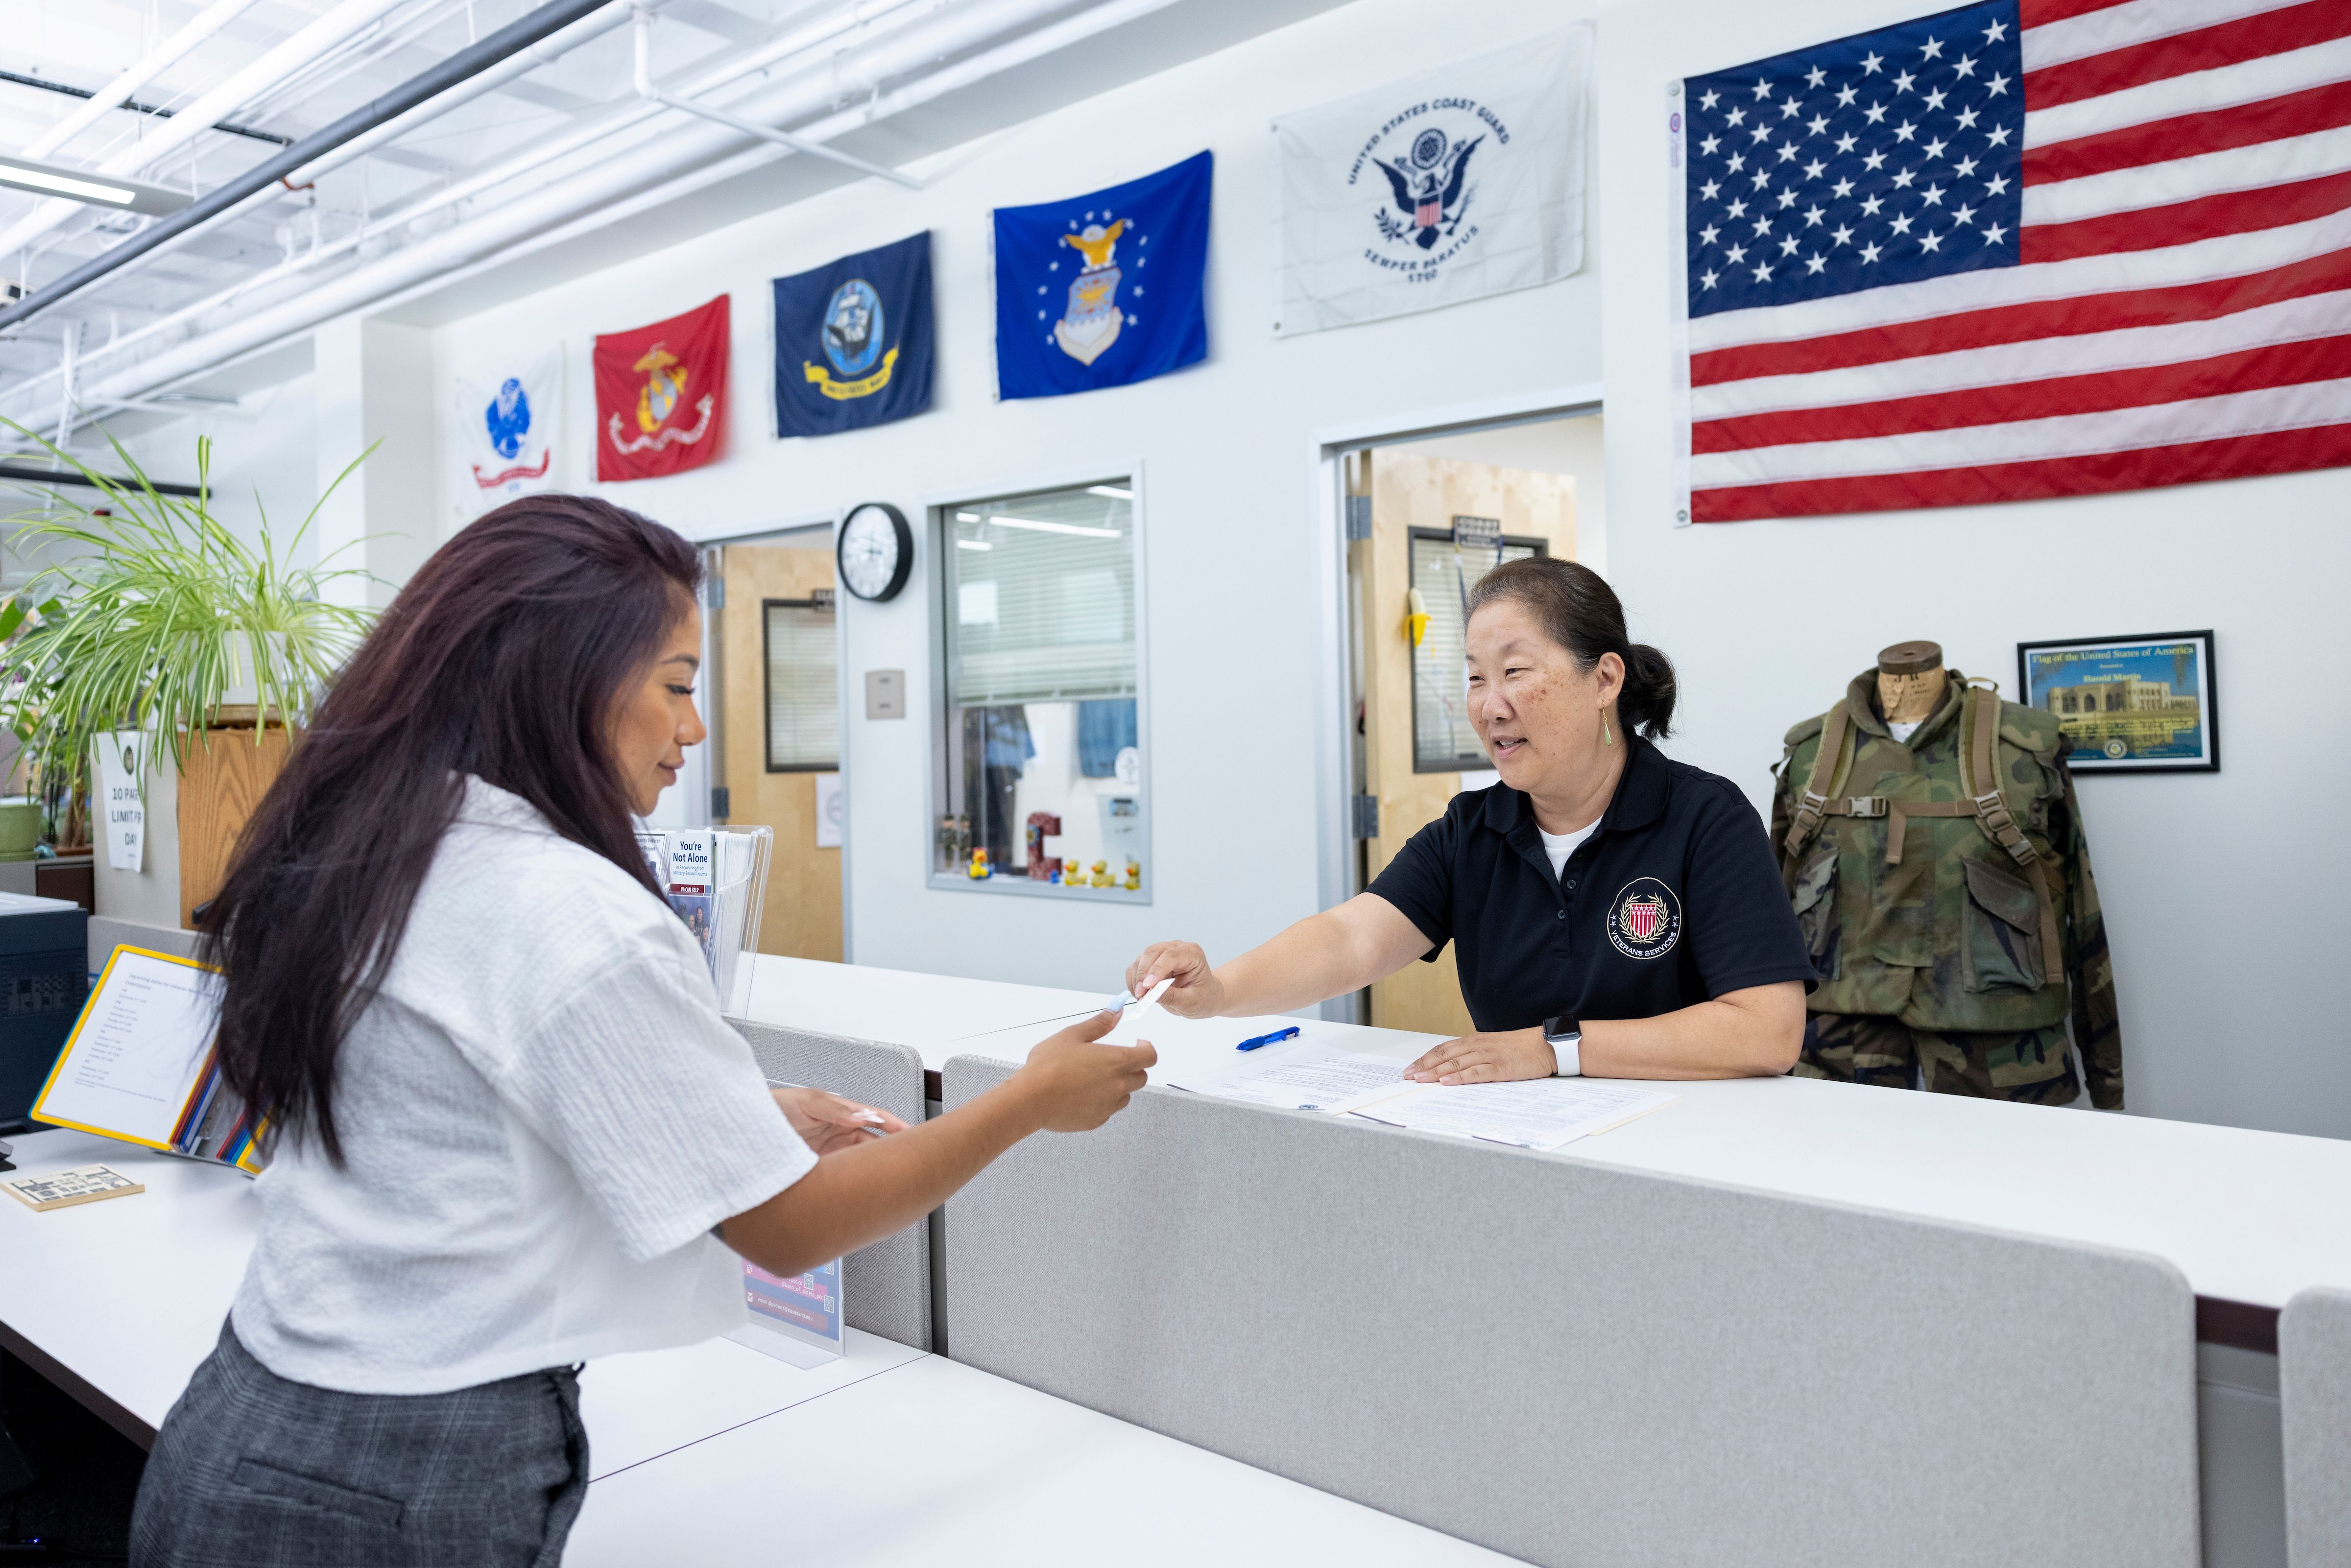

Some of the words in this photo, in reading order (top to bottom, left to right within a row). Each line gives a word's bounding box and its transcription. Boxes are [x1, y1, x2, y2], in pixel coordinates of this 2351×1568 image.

[1347, 134, 1380, 185] UNITED
[1382, 102, 1429, 136] STATES
[1432, 97, 1477, 111] COAST
[1477, 106, 1511, 145] GUARD
[1364, 248, 1417, 272] SEMPER
[1422, 225, 1480, 270] PARATUS
[2082, 650, 2111, 661] United
[2113, 649, 2140, 658] States
[2141, 647, 2152, 657] of
[2155, 645, 2194, 656] America
[112, 787, 122, 800] 10
[112, 810, 133, 823] LIMIT
[124, 833, 137, 846] DAY
[680, 841, 702, 851] You're
[673, 853, 686, 862] Not
[688, 853, 708, 862] Alone
[1611, 929, 1643, 956] VETERANS
[1645, 932, 1677, 956] SERVICES
[768, 1301, 813, 1321] @pccvets@pasadena.edu
